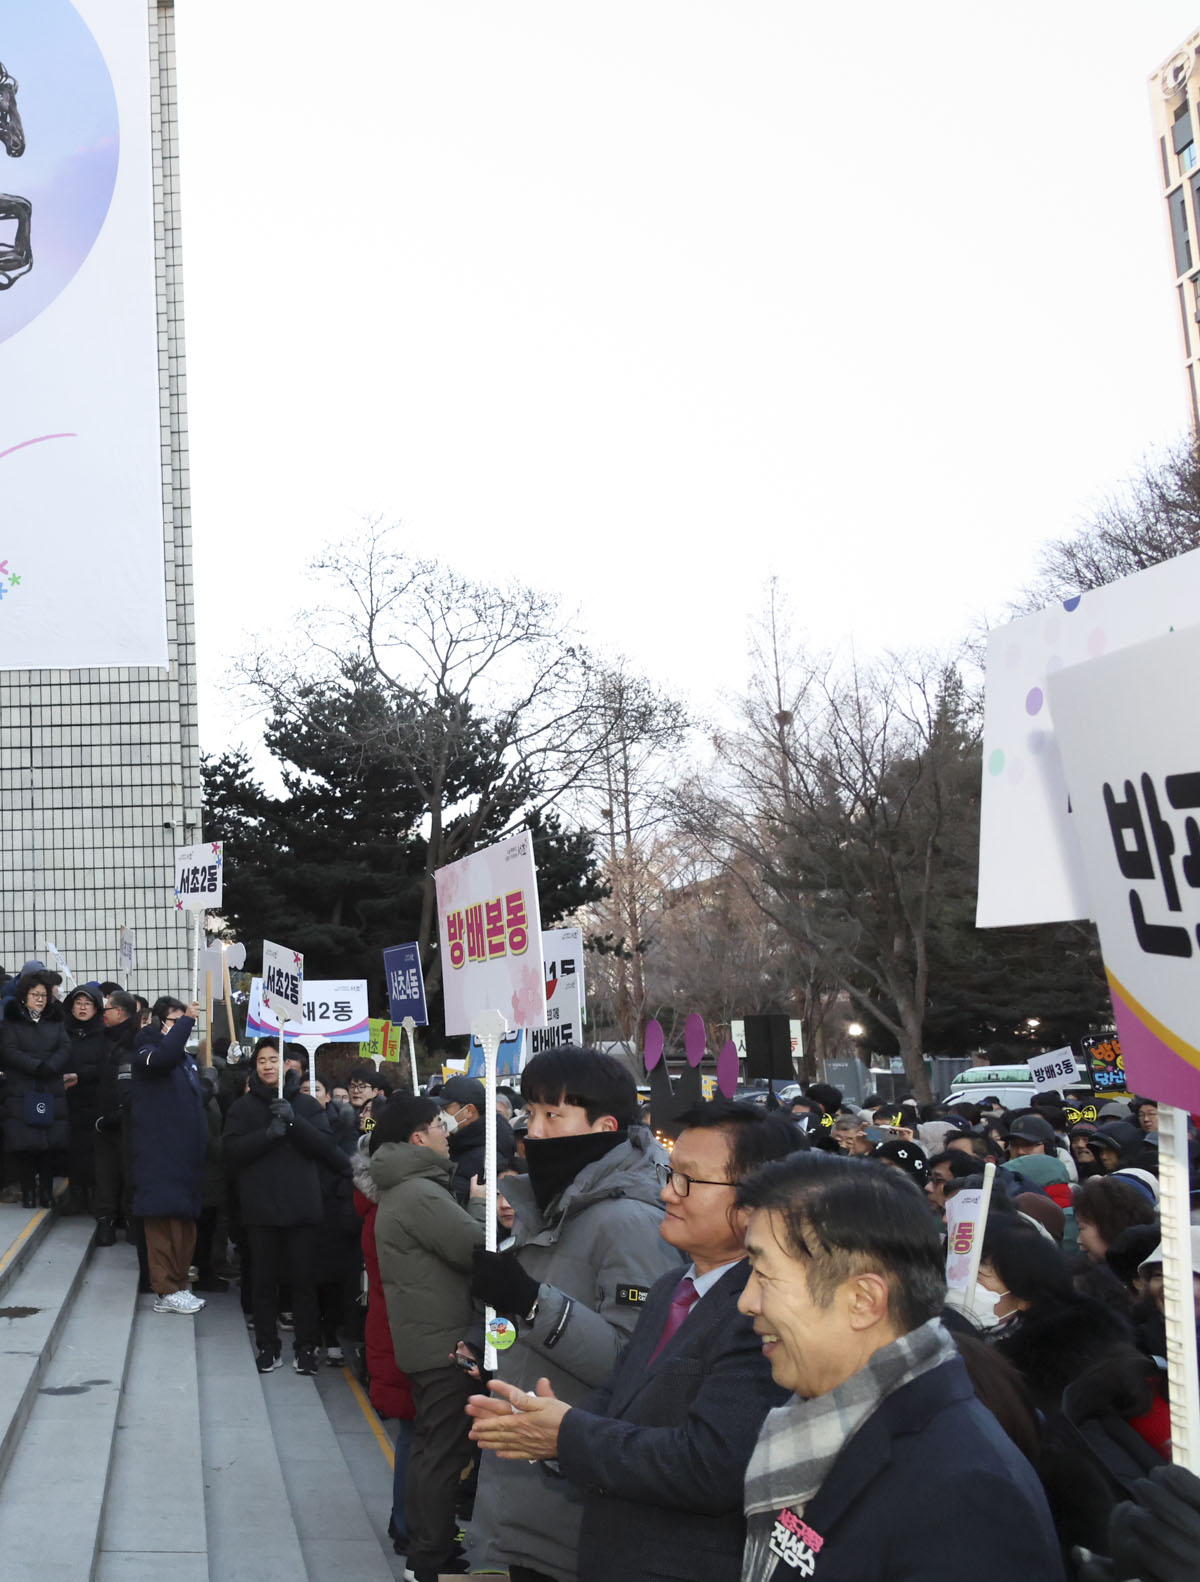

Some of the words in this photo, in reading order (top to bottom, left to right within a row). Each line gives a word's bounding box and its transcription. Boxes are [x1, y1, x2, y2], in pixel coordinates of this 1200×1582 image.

[180, 865, 218, 894] 서초2동
[447, 889, 528, 968] 방배본동
[266, 965, 299, 1006] 서초2동
[390, 968, 420, 1001] 서초4동
[1033, 1059, 1074, 1083] 방배3동
[1095, 1071, 1125, 1086] 당신
[768, 1521, 816, 1578] 전성수
